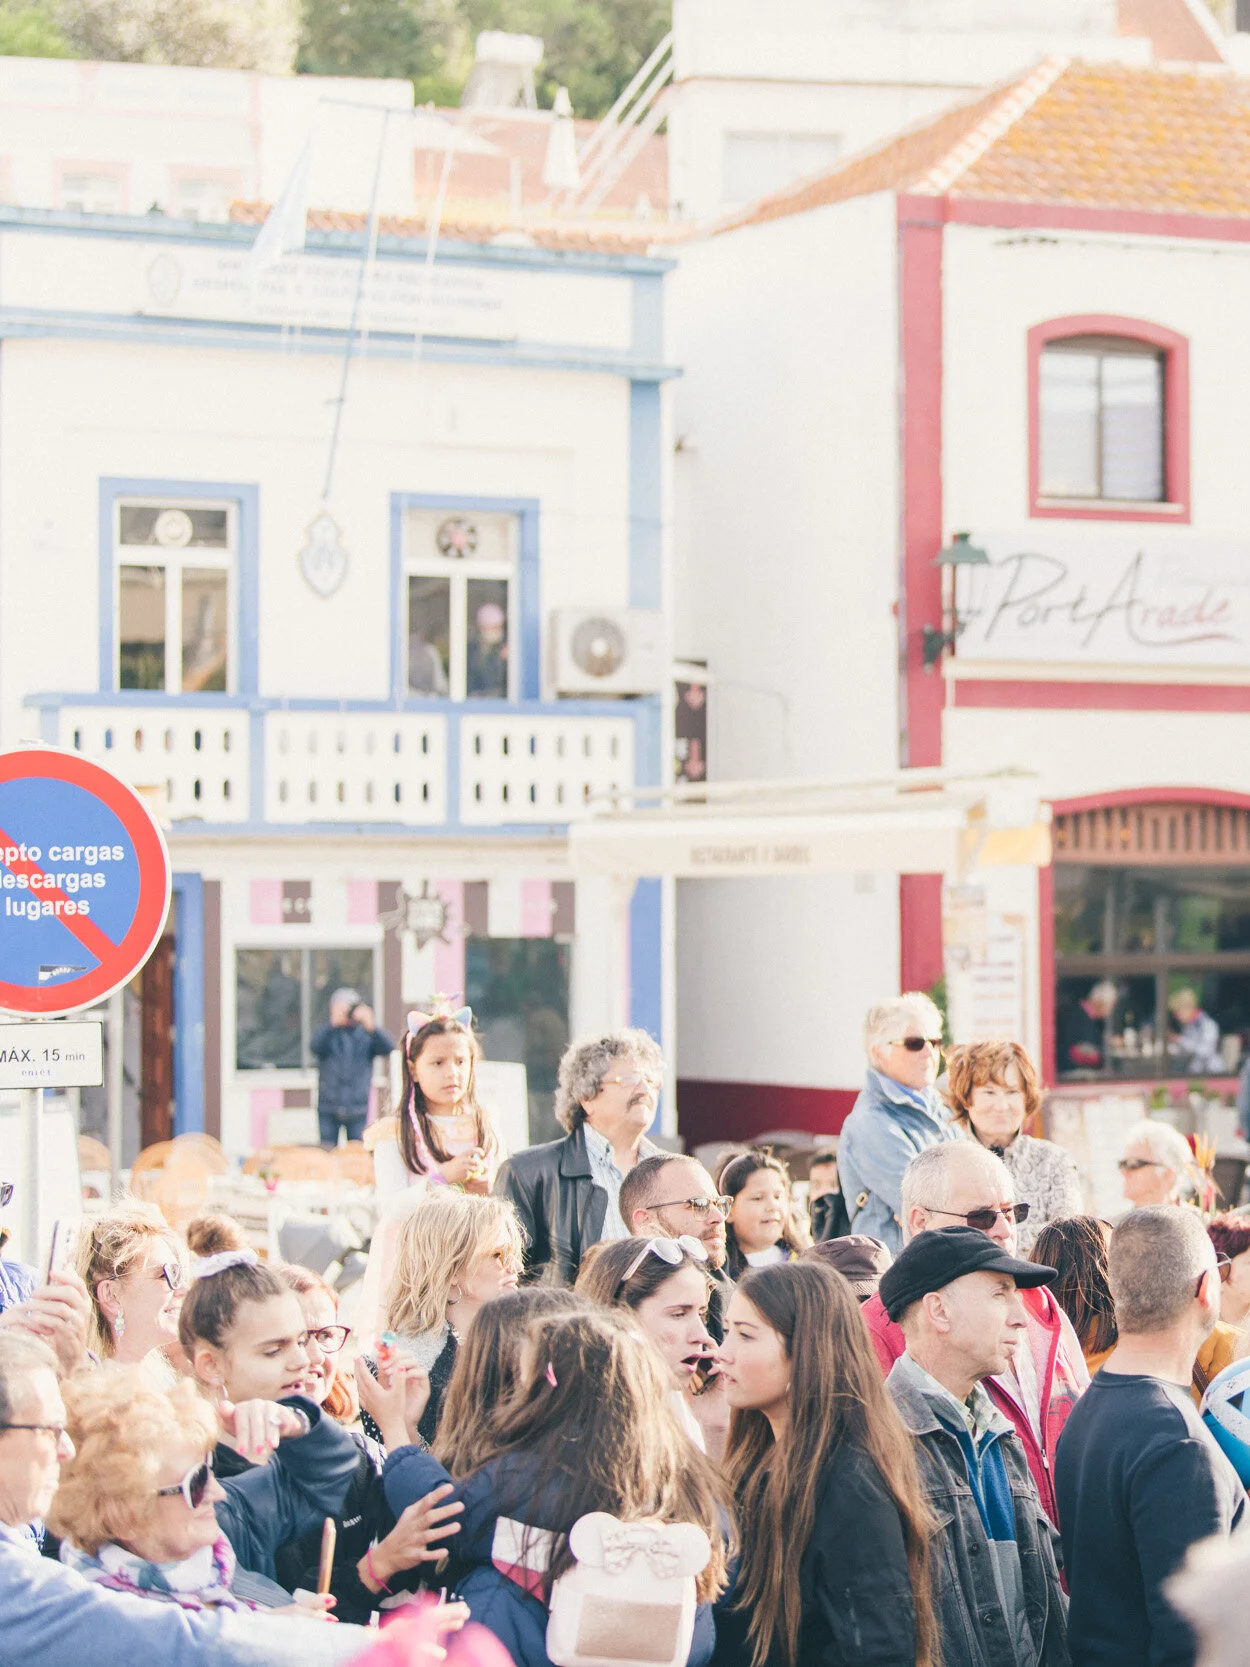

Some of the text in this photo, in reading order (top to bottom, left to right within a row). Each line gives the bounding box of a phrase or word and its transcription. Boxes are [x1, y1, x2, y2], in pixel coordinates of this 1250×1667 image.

[48, 844, 125, 866] cargas
[0, 869, 107, 893] escargas
[5, 896, 90, 921] lugares
[42, 1048, 61, 1062] 15
[65, 1052, 86, 1061] min
